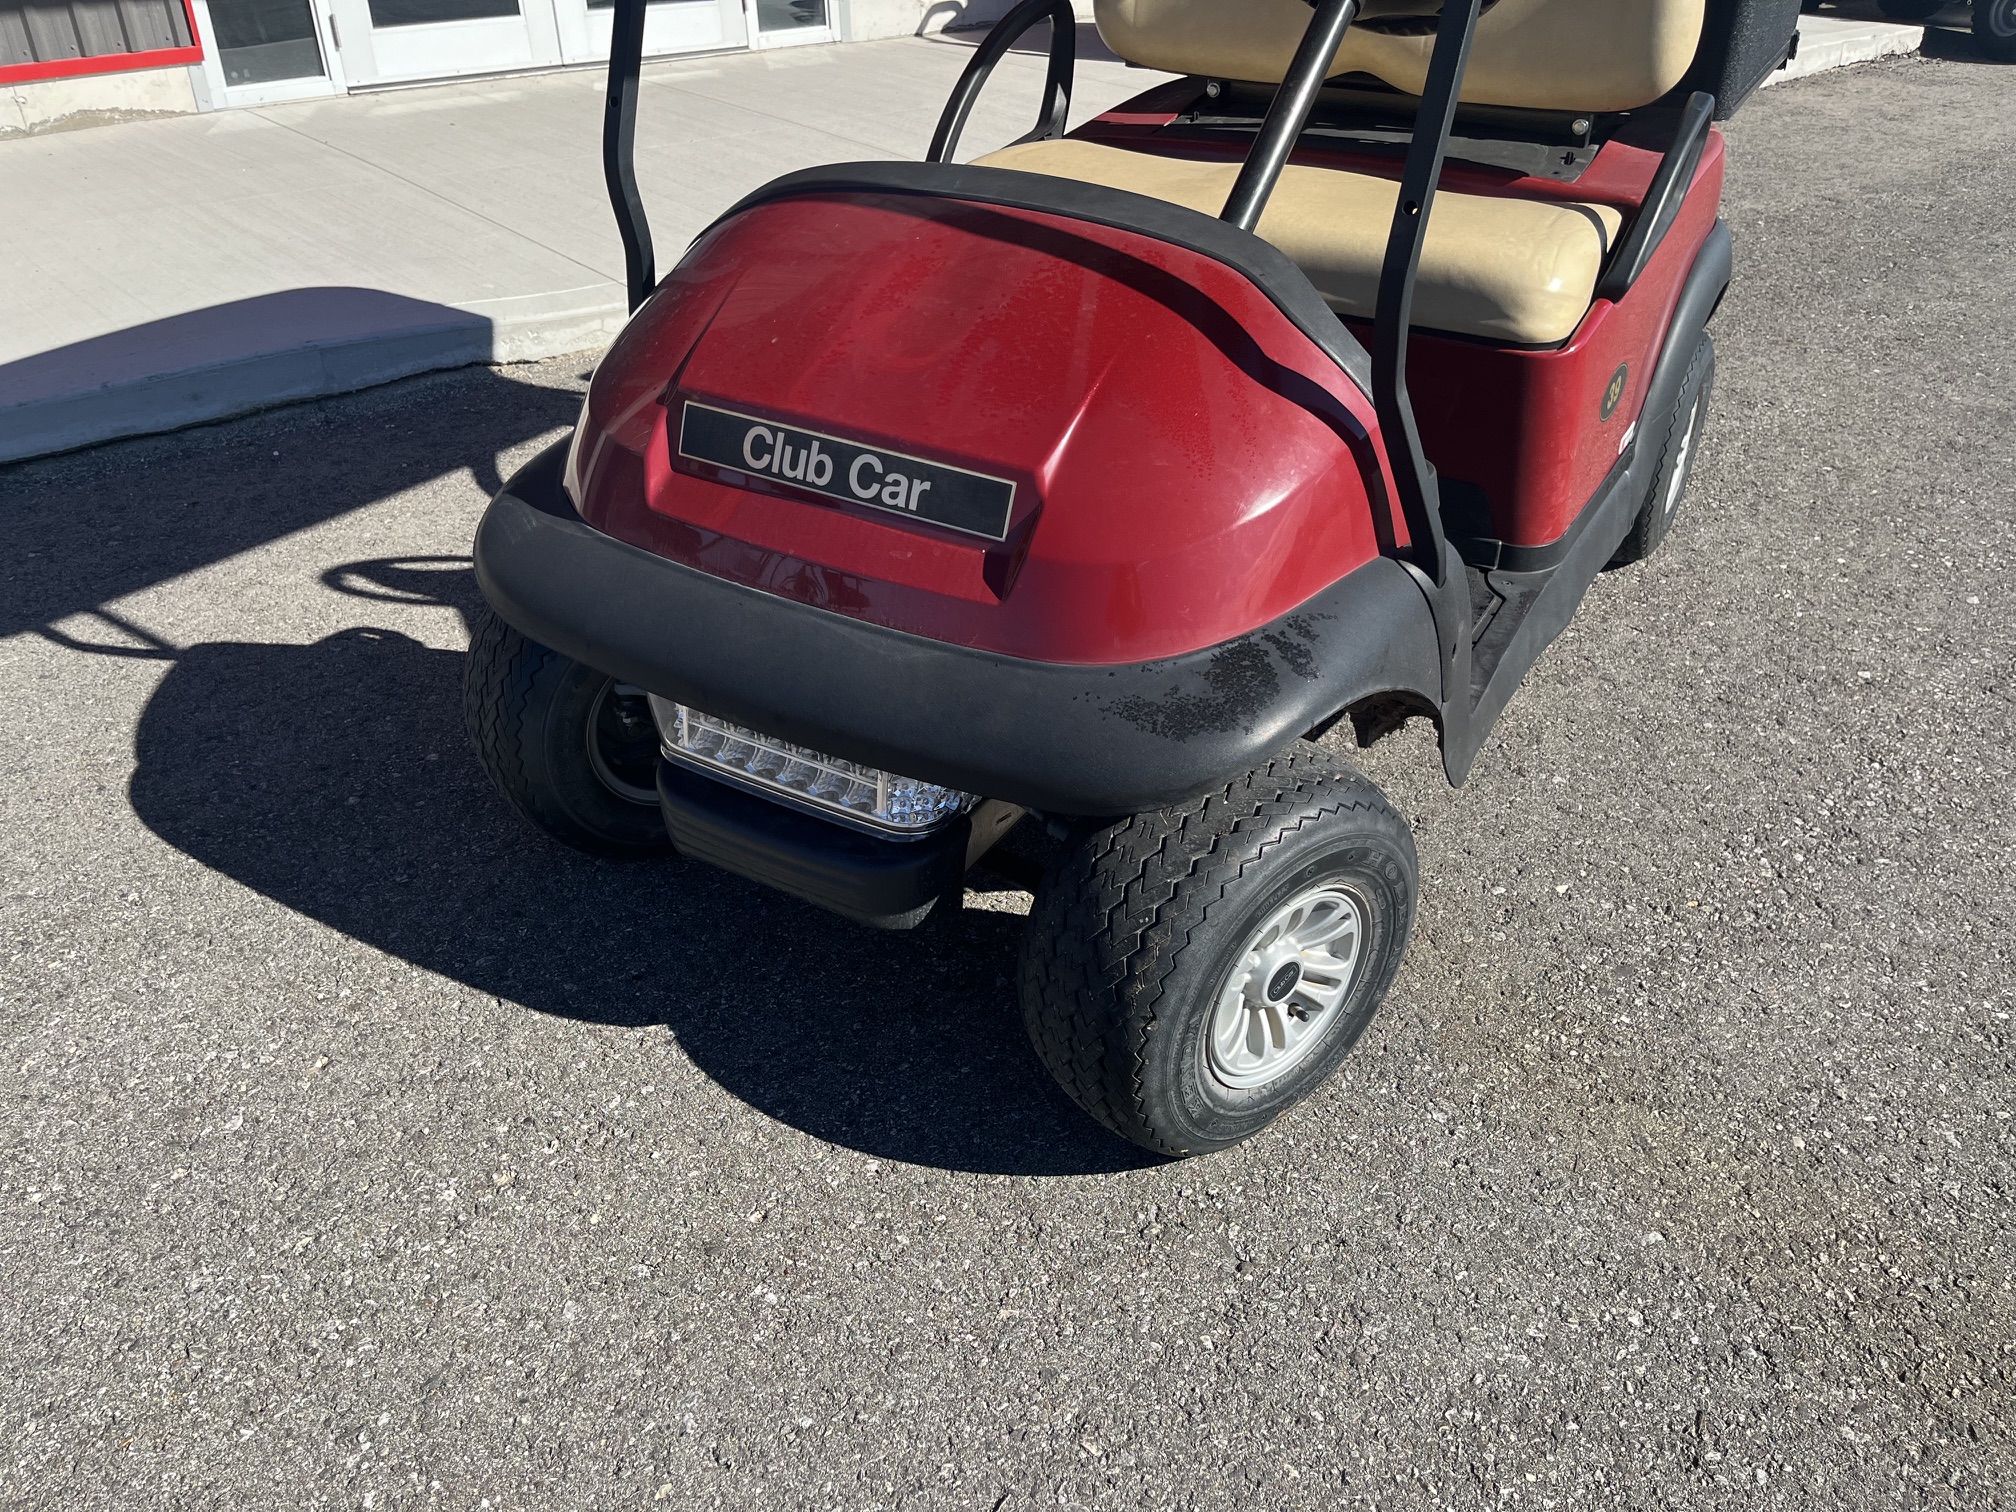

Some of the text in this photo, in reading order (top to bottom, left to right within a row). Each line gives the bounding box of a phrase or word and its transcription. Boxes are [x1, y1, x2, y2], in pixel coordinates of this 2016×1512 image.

[1606, 375, 1622, 410] 39
[742, 426, 931, 511] Club Car
